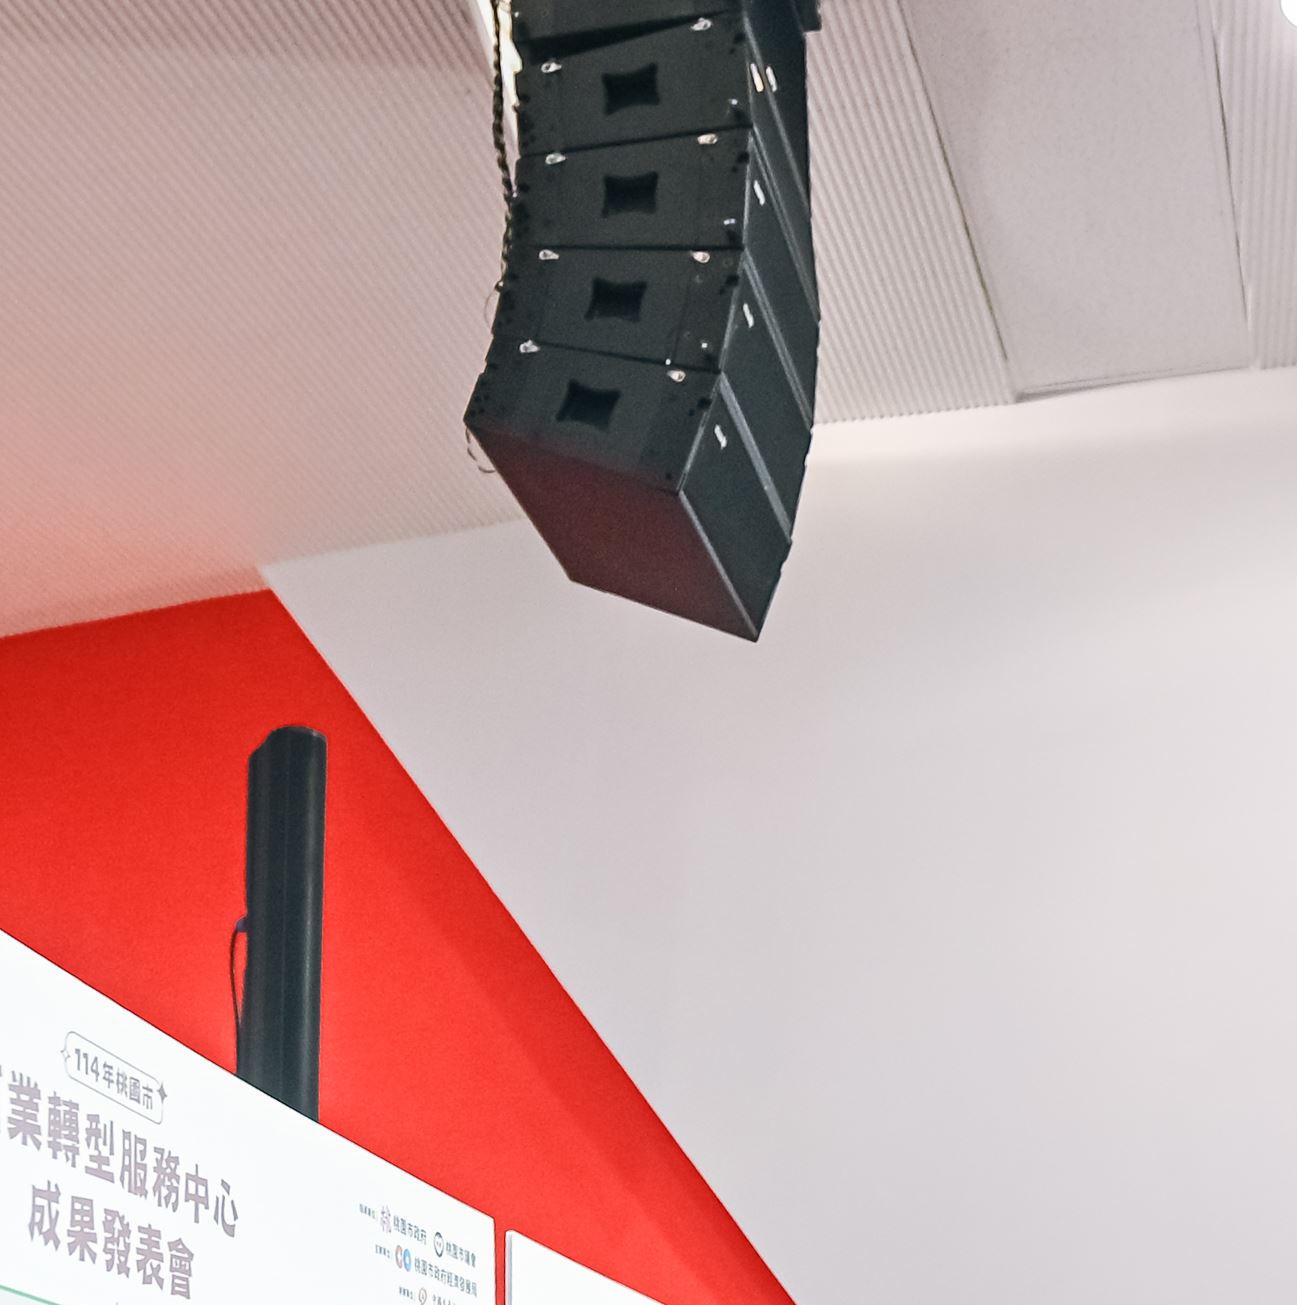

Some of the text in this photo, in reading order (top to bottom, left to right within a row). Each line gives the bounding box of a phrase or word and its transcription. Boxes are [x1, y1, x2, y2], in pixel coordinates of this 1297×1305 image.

[74, 1047, 155, 1111] 114年桃園市
[27, 1179, 195, 1301] 成果發表會
